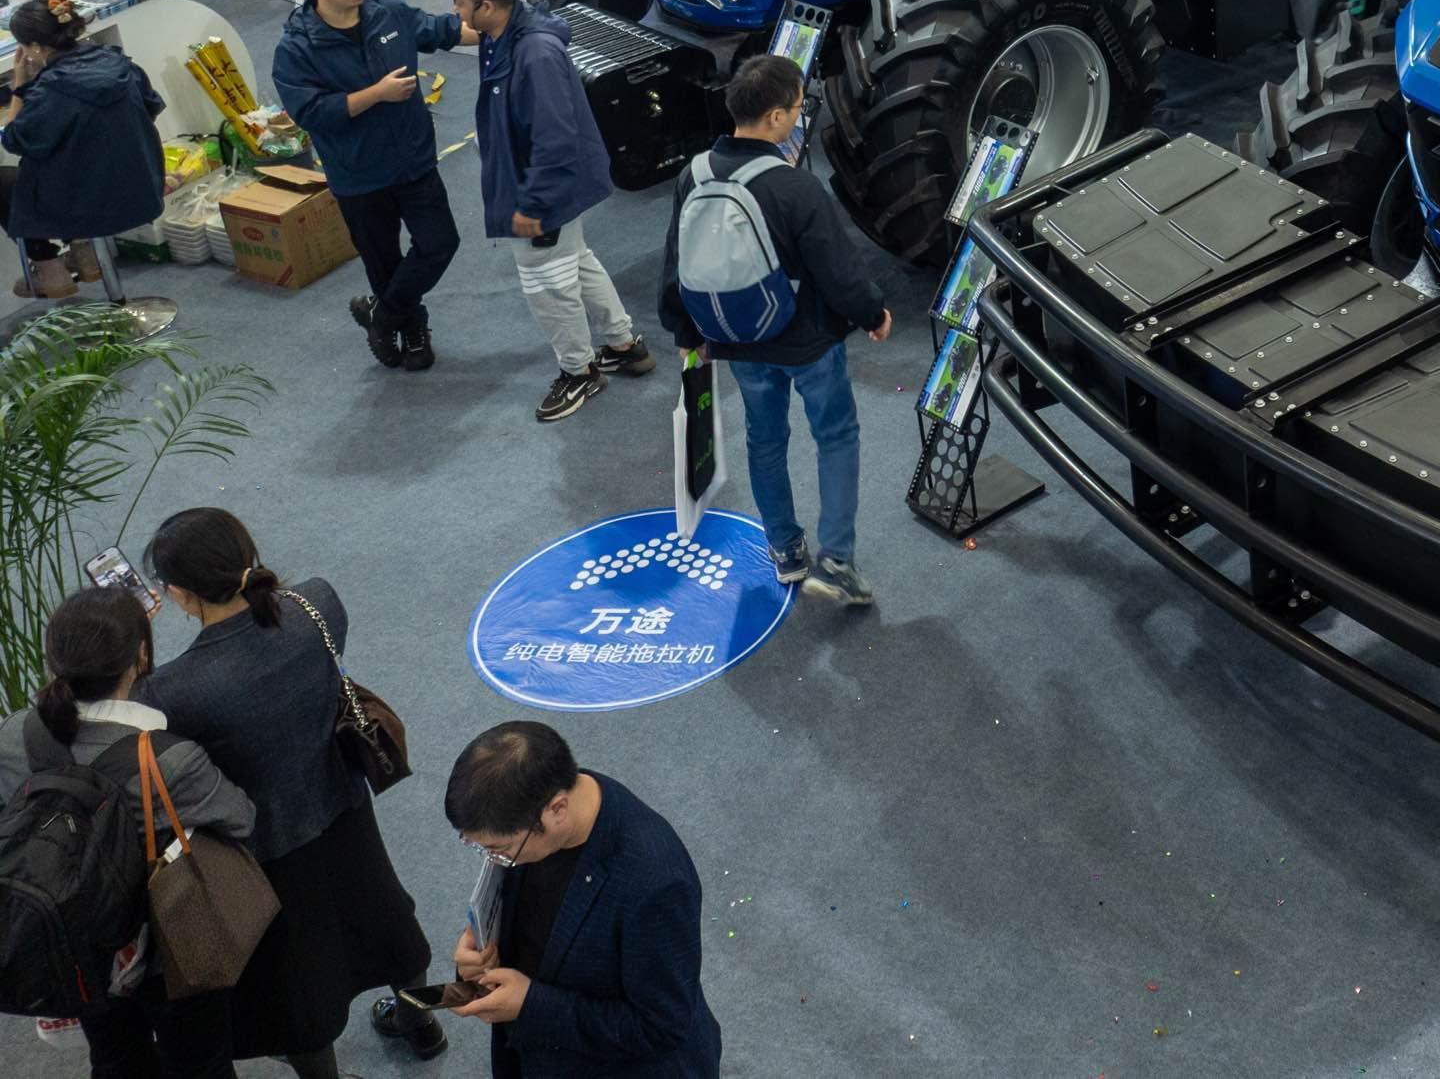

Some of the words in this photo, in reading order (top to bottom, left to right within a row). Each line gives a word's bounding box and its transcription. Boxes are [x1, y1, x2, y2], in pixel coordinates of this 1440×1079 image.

[579, 606, 676, 636] 万途
[502, 641, 716, 665] 纯电智能拖拉机
